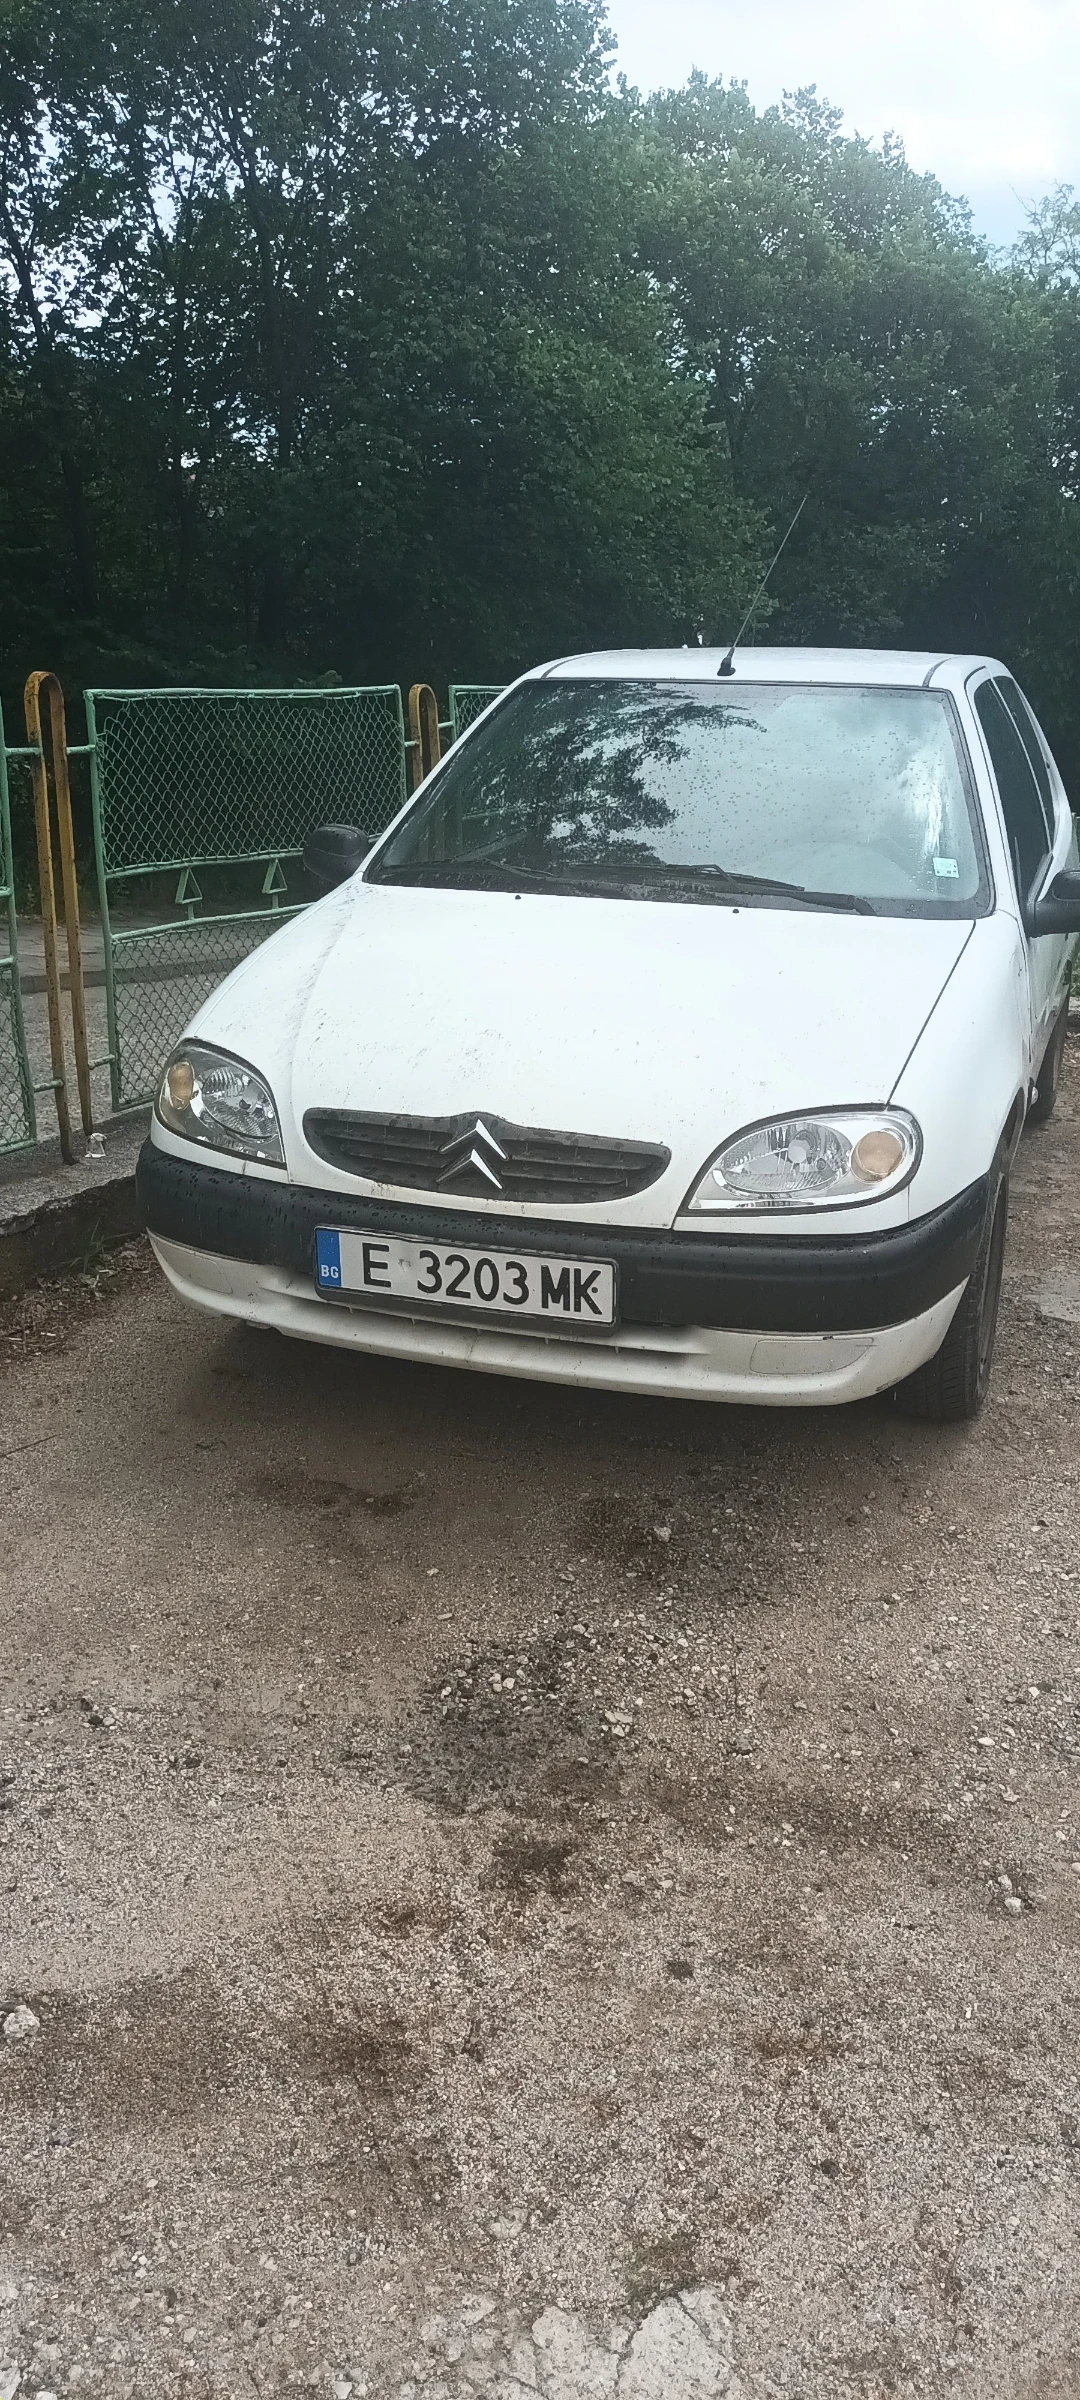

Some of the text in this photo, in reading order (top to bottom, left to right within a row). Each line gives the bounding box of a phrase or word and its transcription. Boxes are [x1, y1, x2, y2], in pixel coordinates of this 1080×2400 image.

[321, 1264, 339, 1279] BG
[362, 1242, 603, 1315] E 3203 MK
